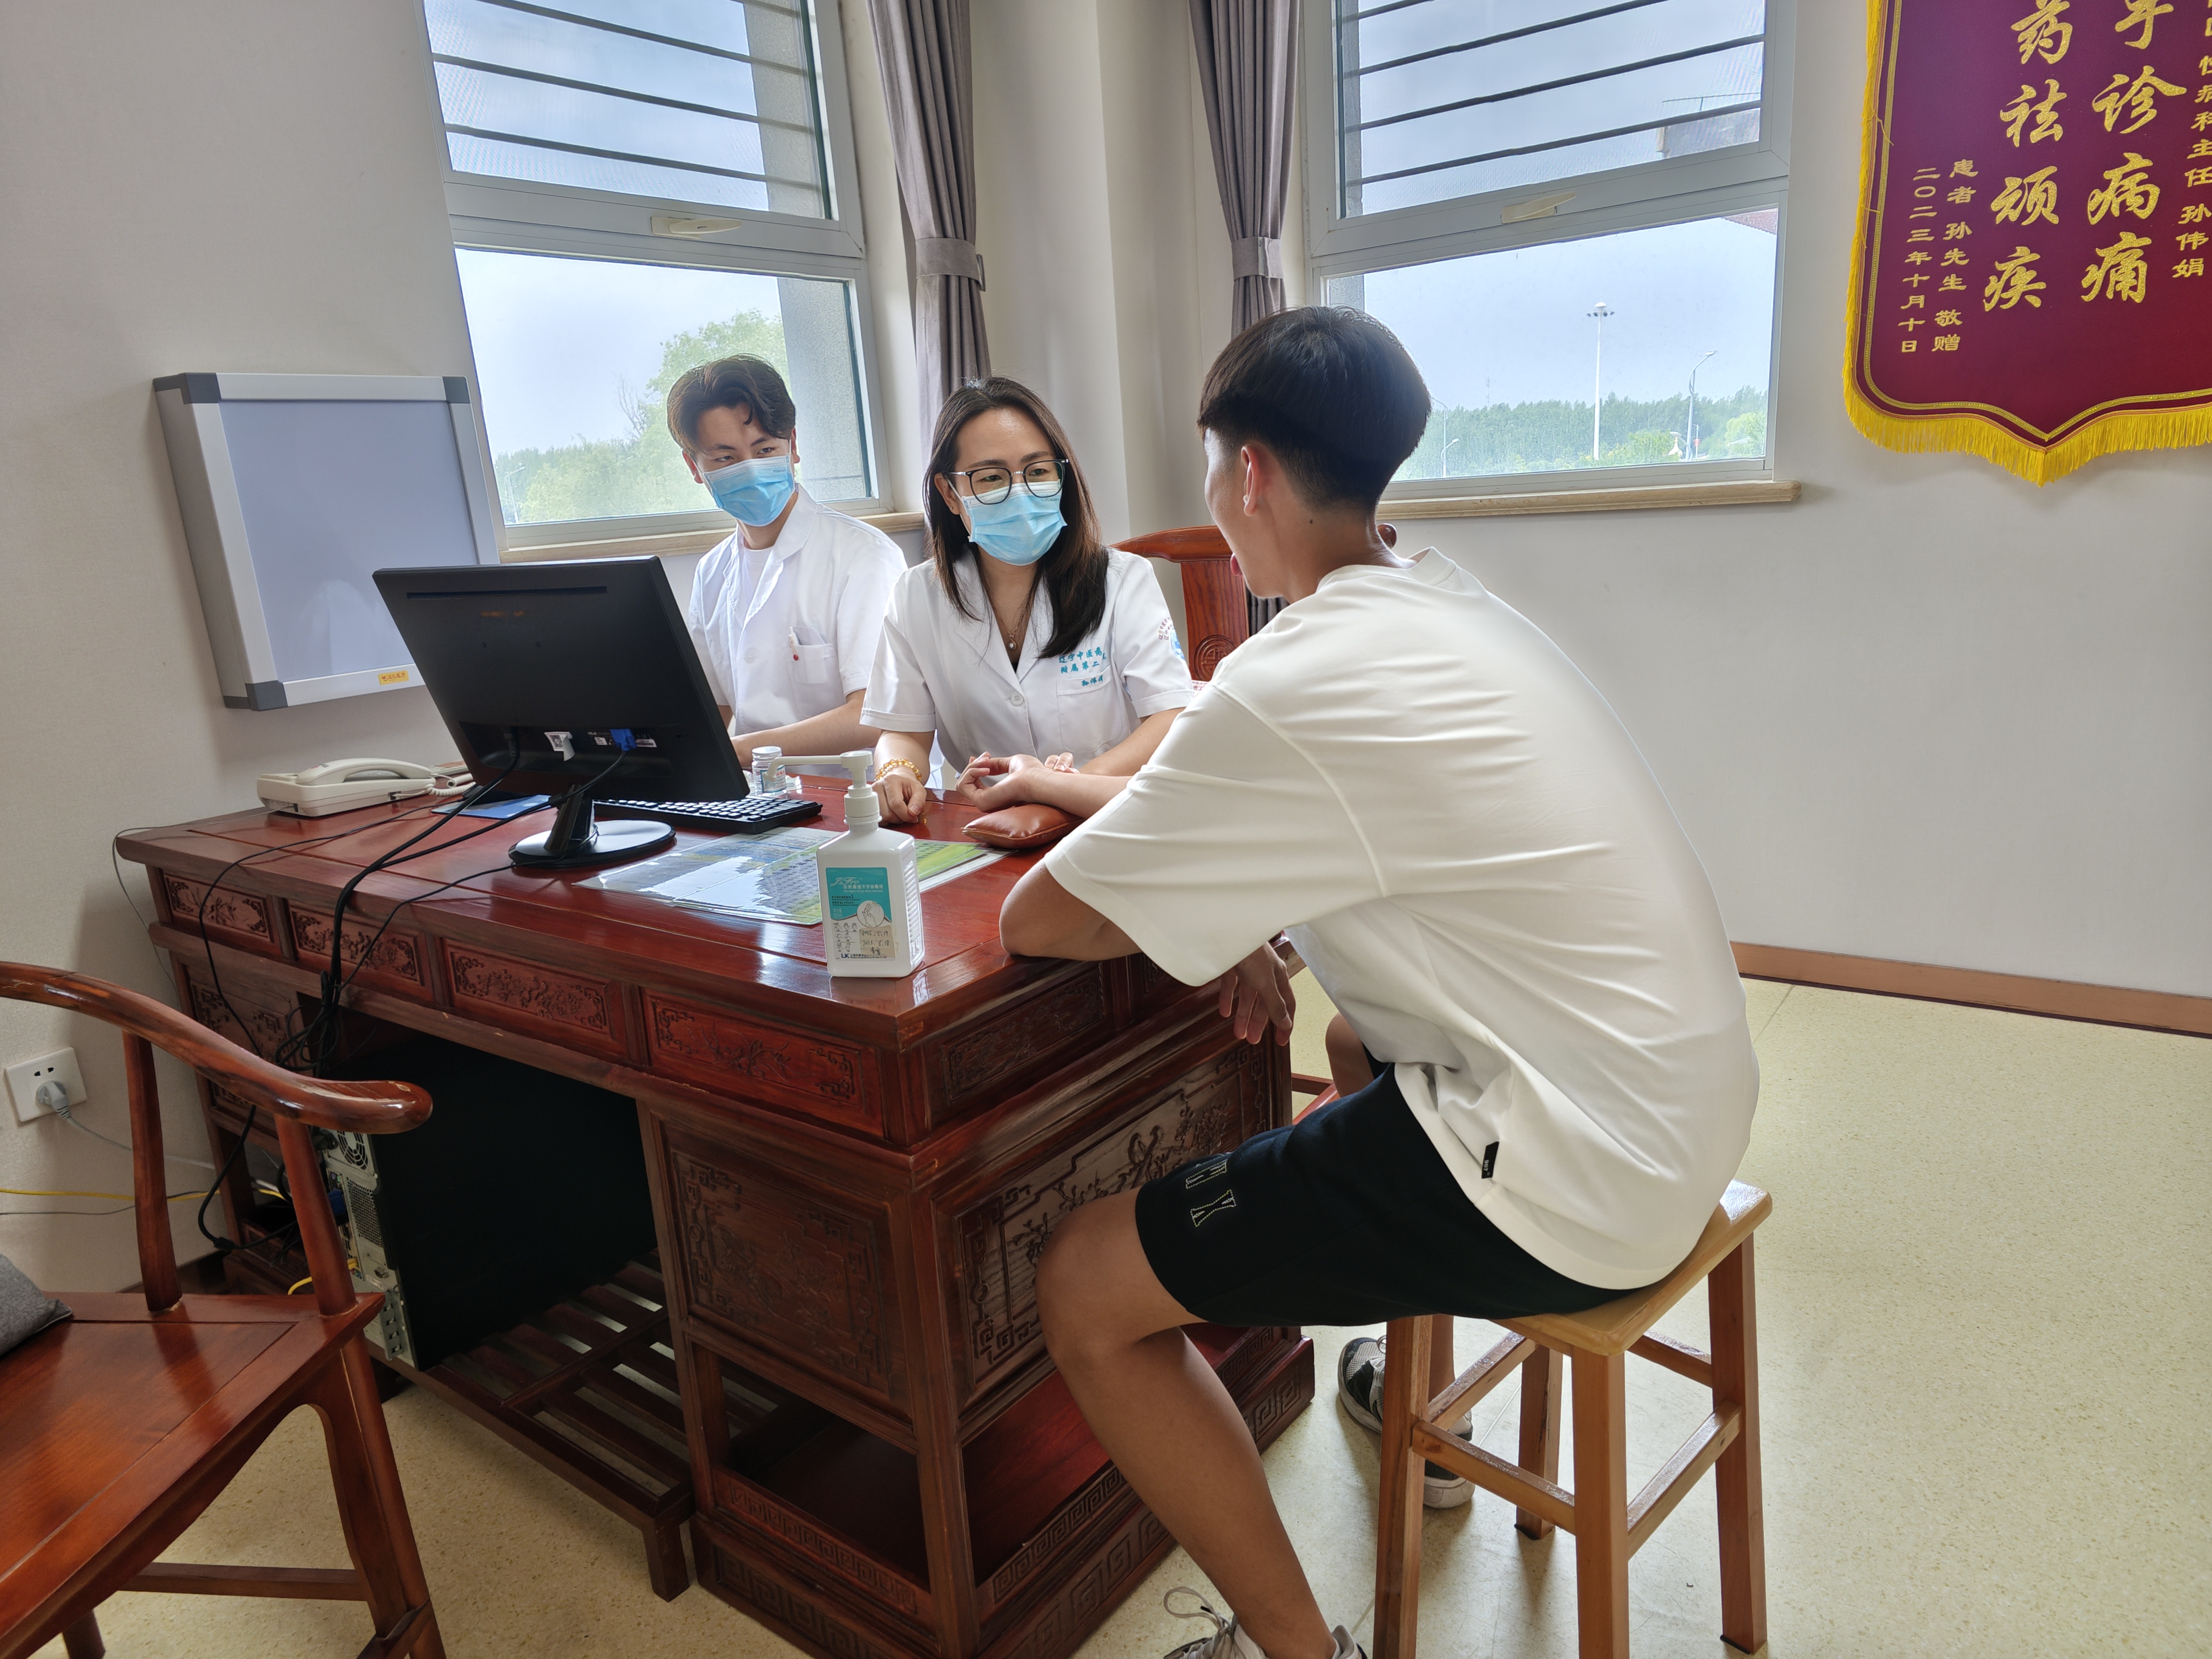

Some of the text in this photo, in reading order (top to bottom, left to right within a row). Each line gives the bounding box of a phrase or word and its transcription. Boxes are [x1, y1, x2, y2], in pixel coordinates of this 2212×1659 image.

[1931, 159, 1979, 352] 患者 孙先生 敬赠
[1982, 0, 2073, 312] 药祛顽疾
[2081, 0, 2187, 304] 手诊病痛
[2171, 203, 2212, 278] 孙伟娟
